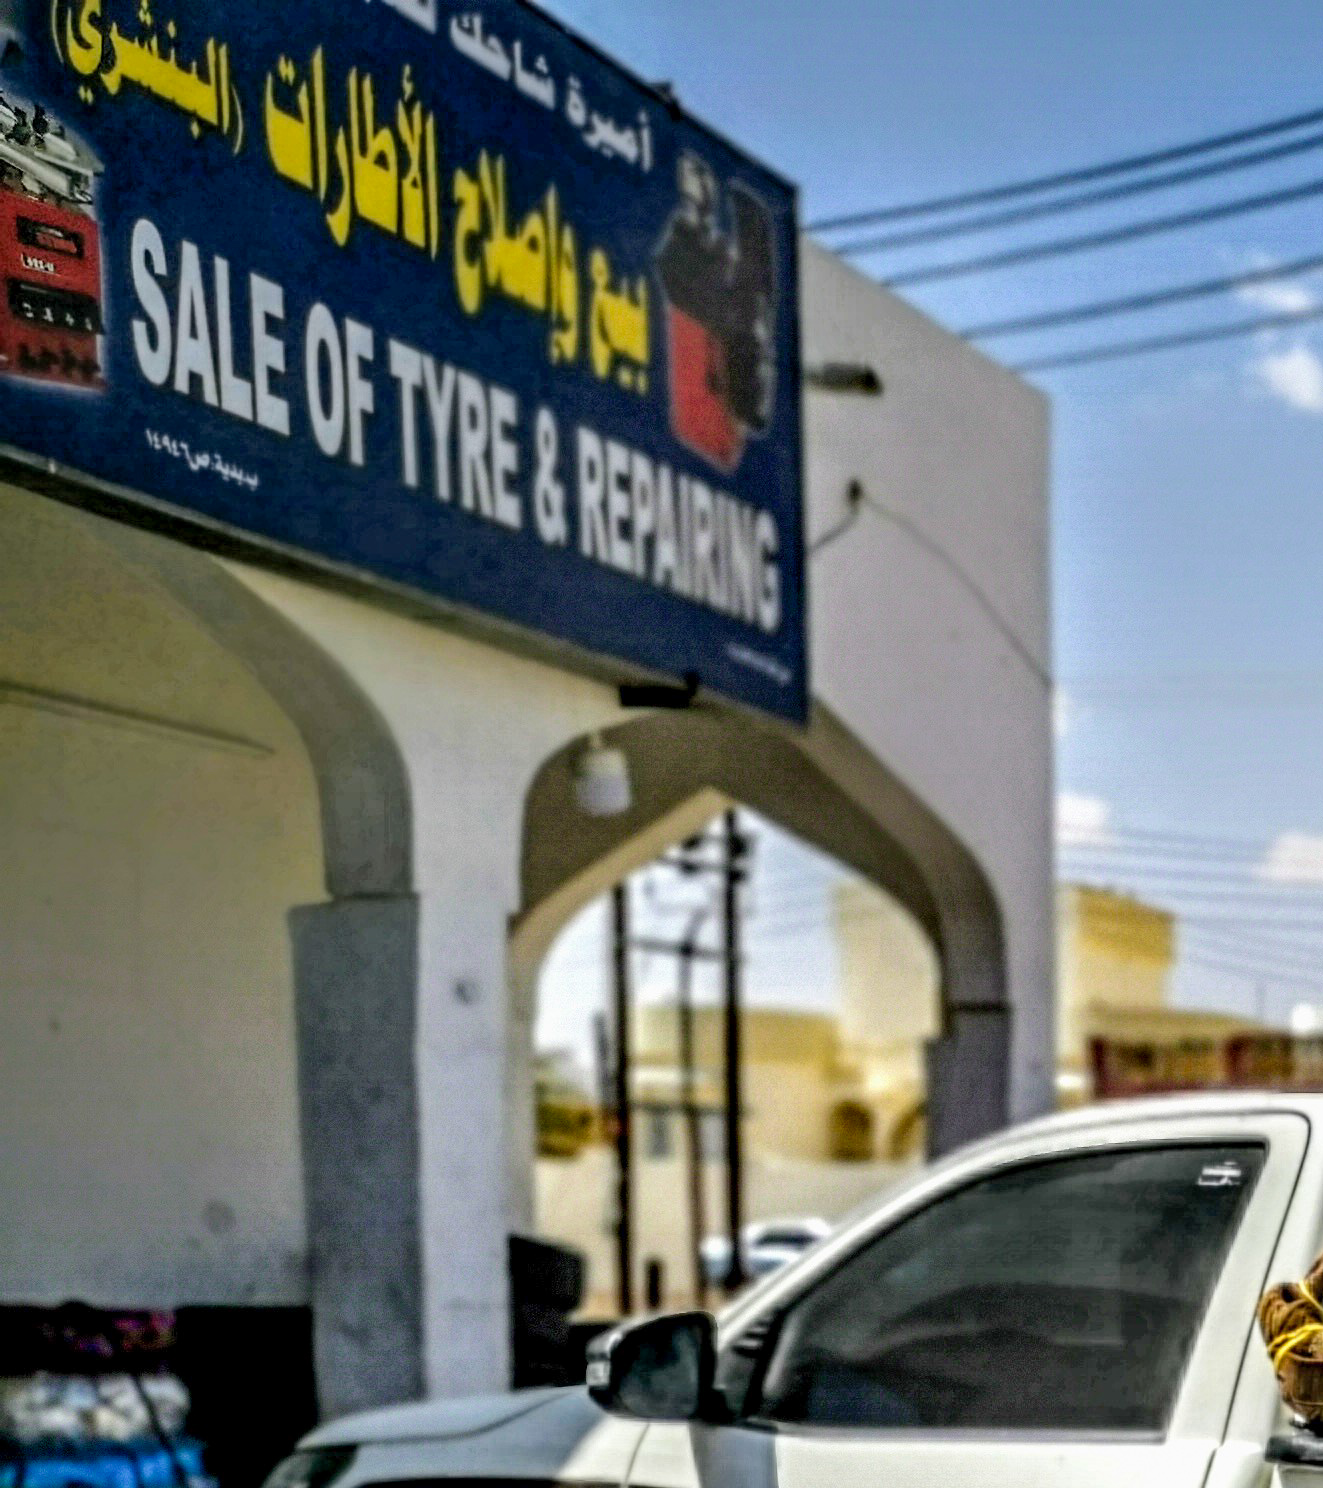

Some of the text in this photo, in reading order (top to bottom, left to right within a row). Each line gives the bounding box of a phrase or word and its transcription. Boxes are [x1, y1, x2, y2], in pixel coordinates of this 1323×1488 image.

[265, 43, 440, 263] الأطارات
[564, 72, 653, 174] أميرة
[590, 249, 649, 395] بيع
[130, 218, 782, 634] SALE OF TYRE & REPAIRING
